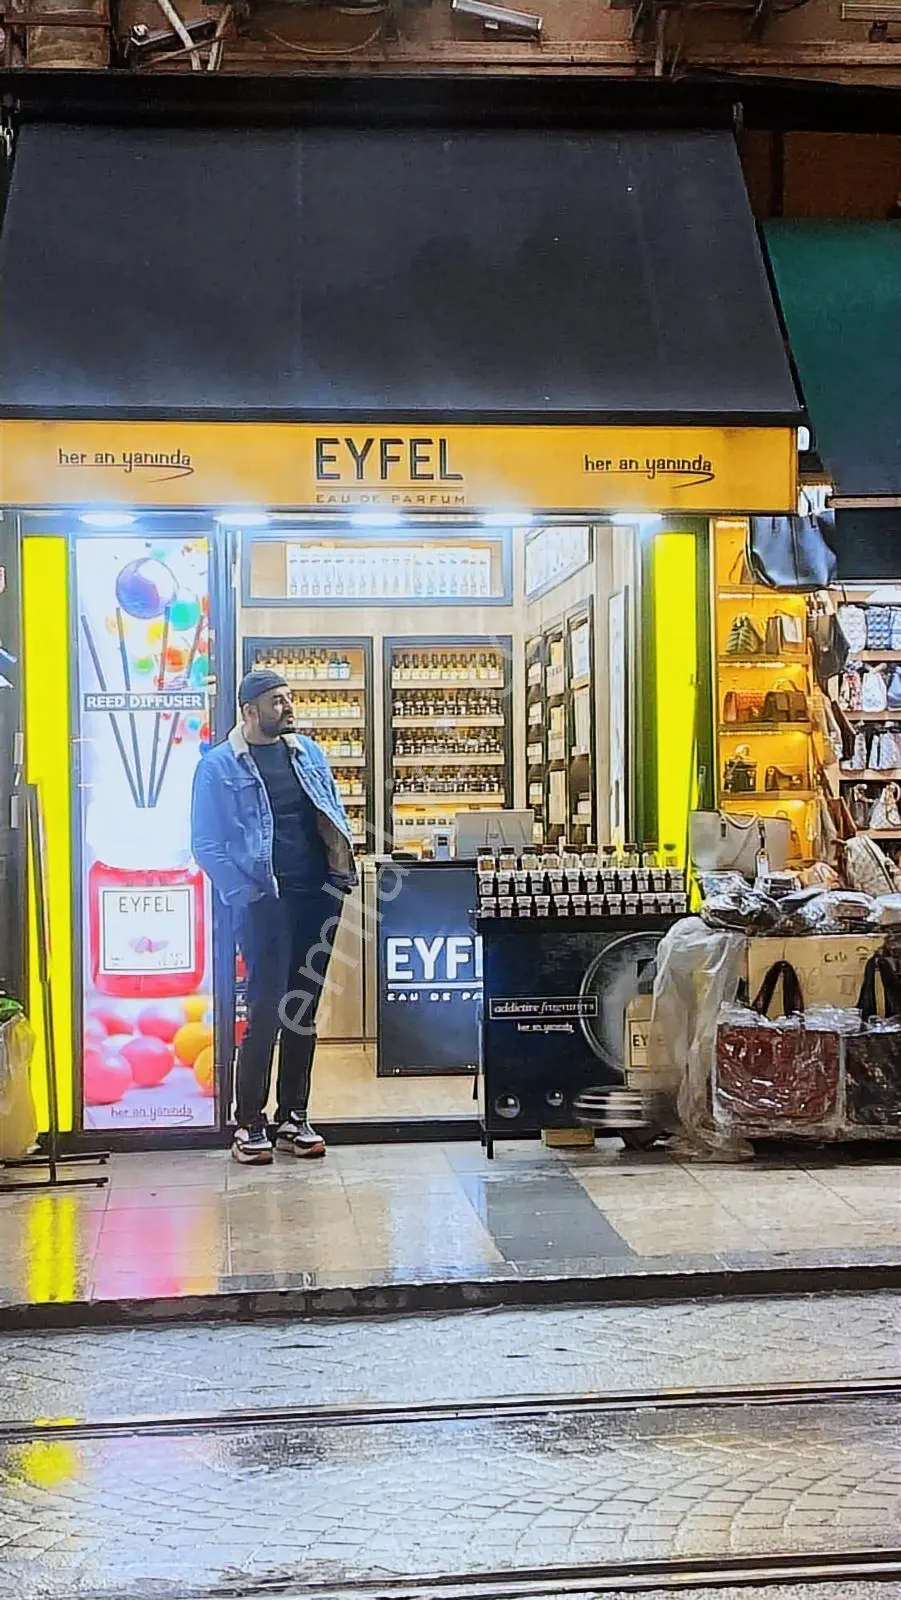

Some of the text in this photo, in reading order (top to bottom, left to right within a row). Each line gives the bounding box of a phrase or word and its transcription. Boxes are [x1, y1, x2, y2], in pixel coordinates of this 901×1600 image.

[58, 448, 88, 465] her
[94, 452, 115, 464] an
[315, 437, 463, 481] EYFEL
[584, 454, 612, 471] her
[619, 459, 639, 470] an
[316, 494, 351, 504] EAU
[391, 494, 465, 504] PARFUM
[86, 694, 202, 708] REED DIFFUSER
[118, 896, 175, 913] EYFEL
[387, 991, 419, 1002] EAU
[430, 991, 452, 1002] DE
